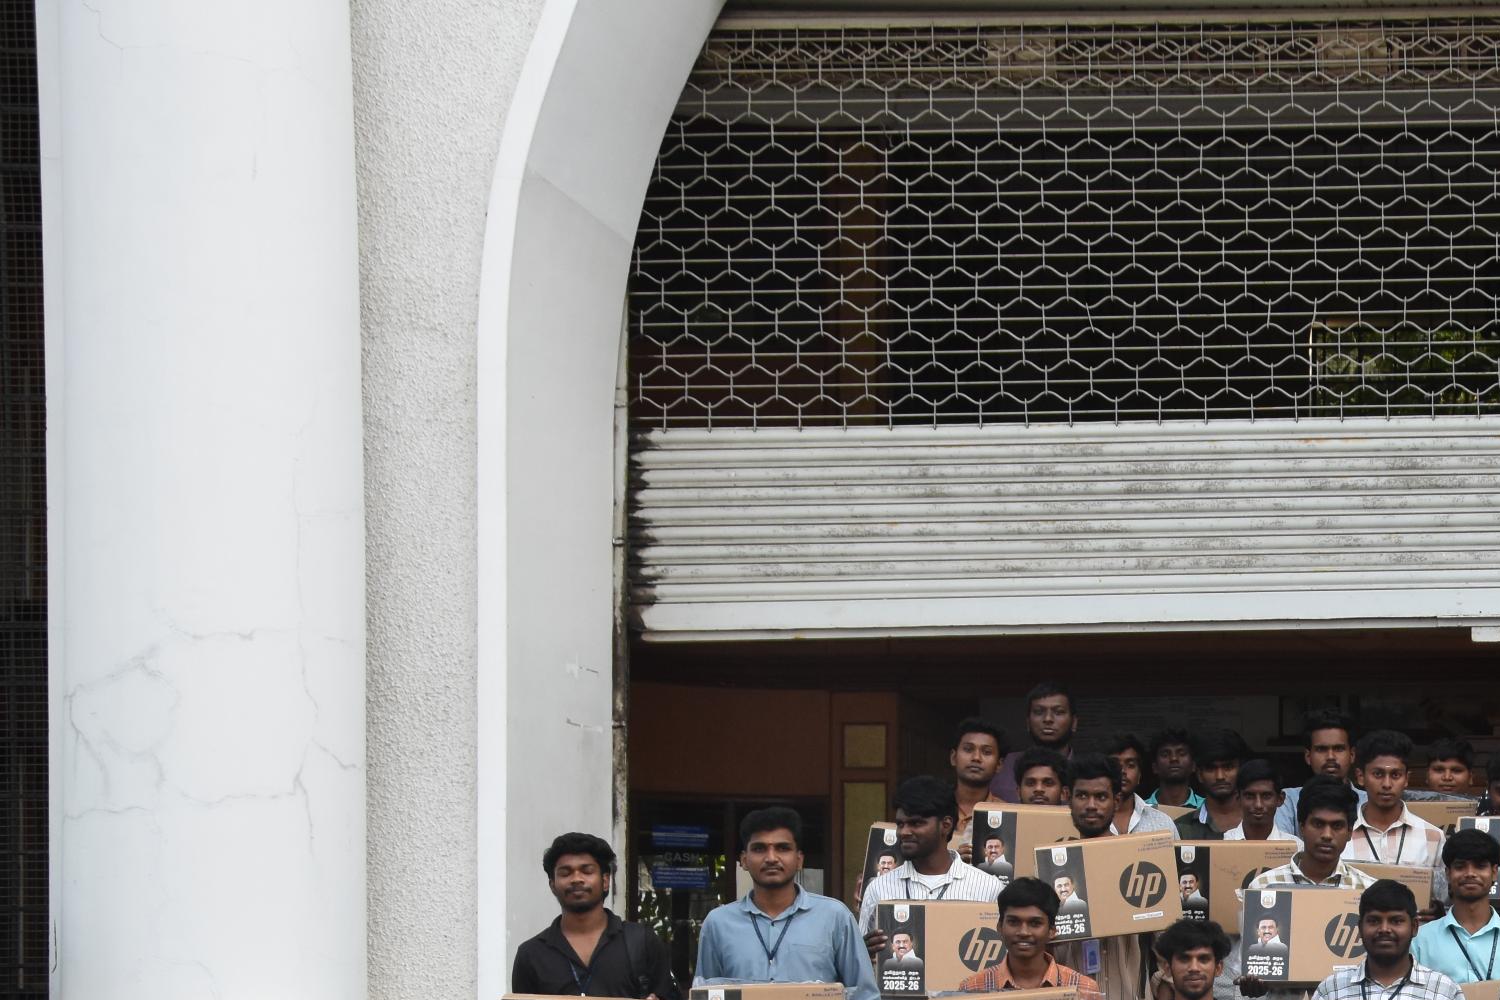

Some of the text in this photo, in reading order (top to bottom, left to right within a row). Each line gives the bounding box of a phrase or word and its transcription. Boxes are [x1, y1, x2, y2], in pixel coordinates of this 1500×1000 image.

[1126, 861, 1161, 908] hp
[1056, 924, 1085, 934] 025-26
[964, 927, 1003, 972] hp
[1248, 966, 1283, 976] 2025-26
[883, 980, 919, 991] 2025-26
